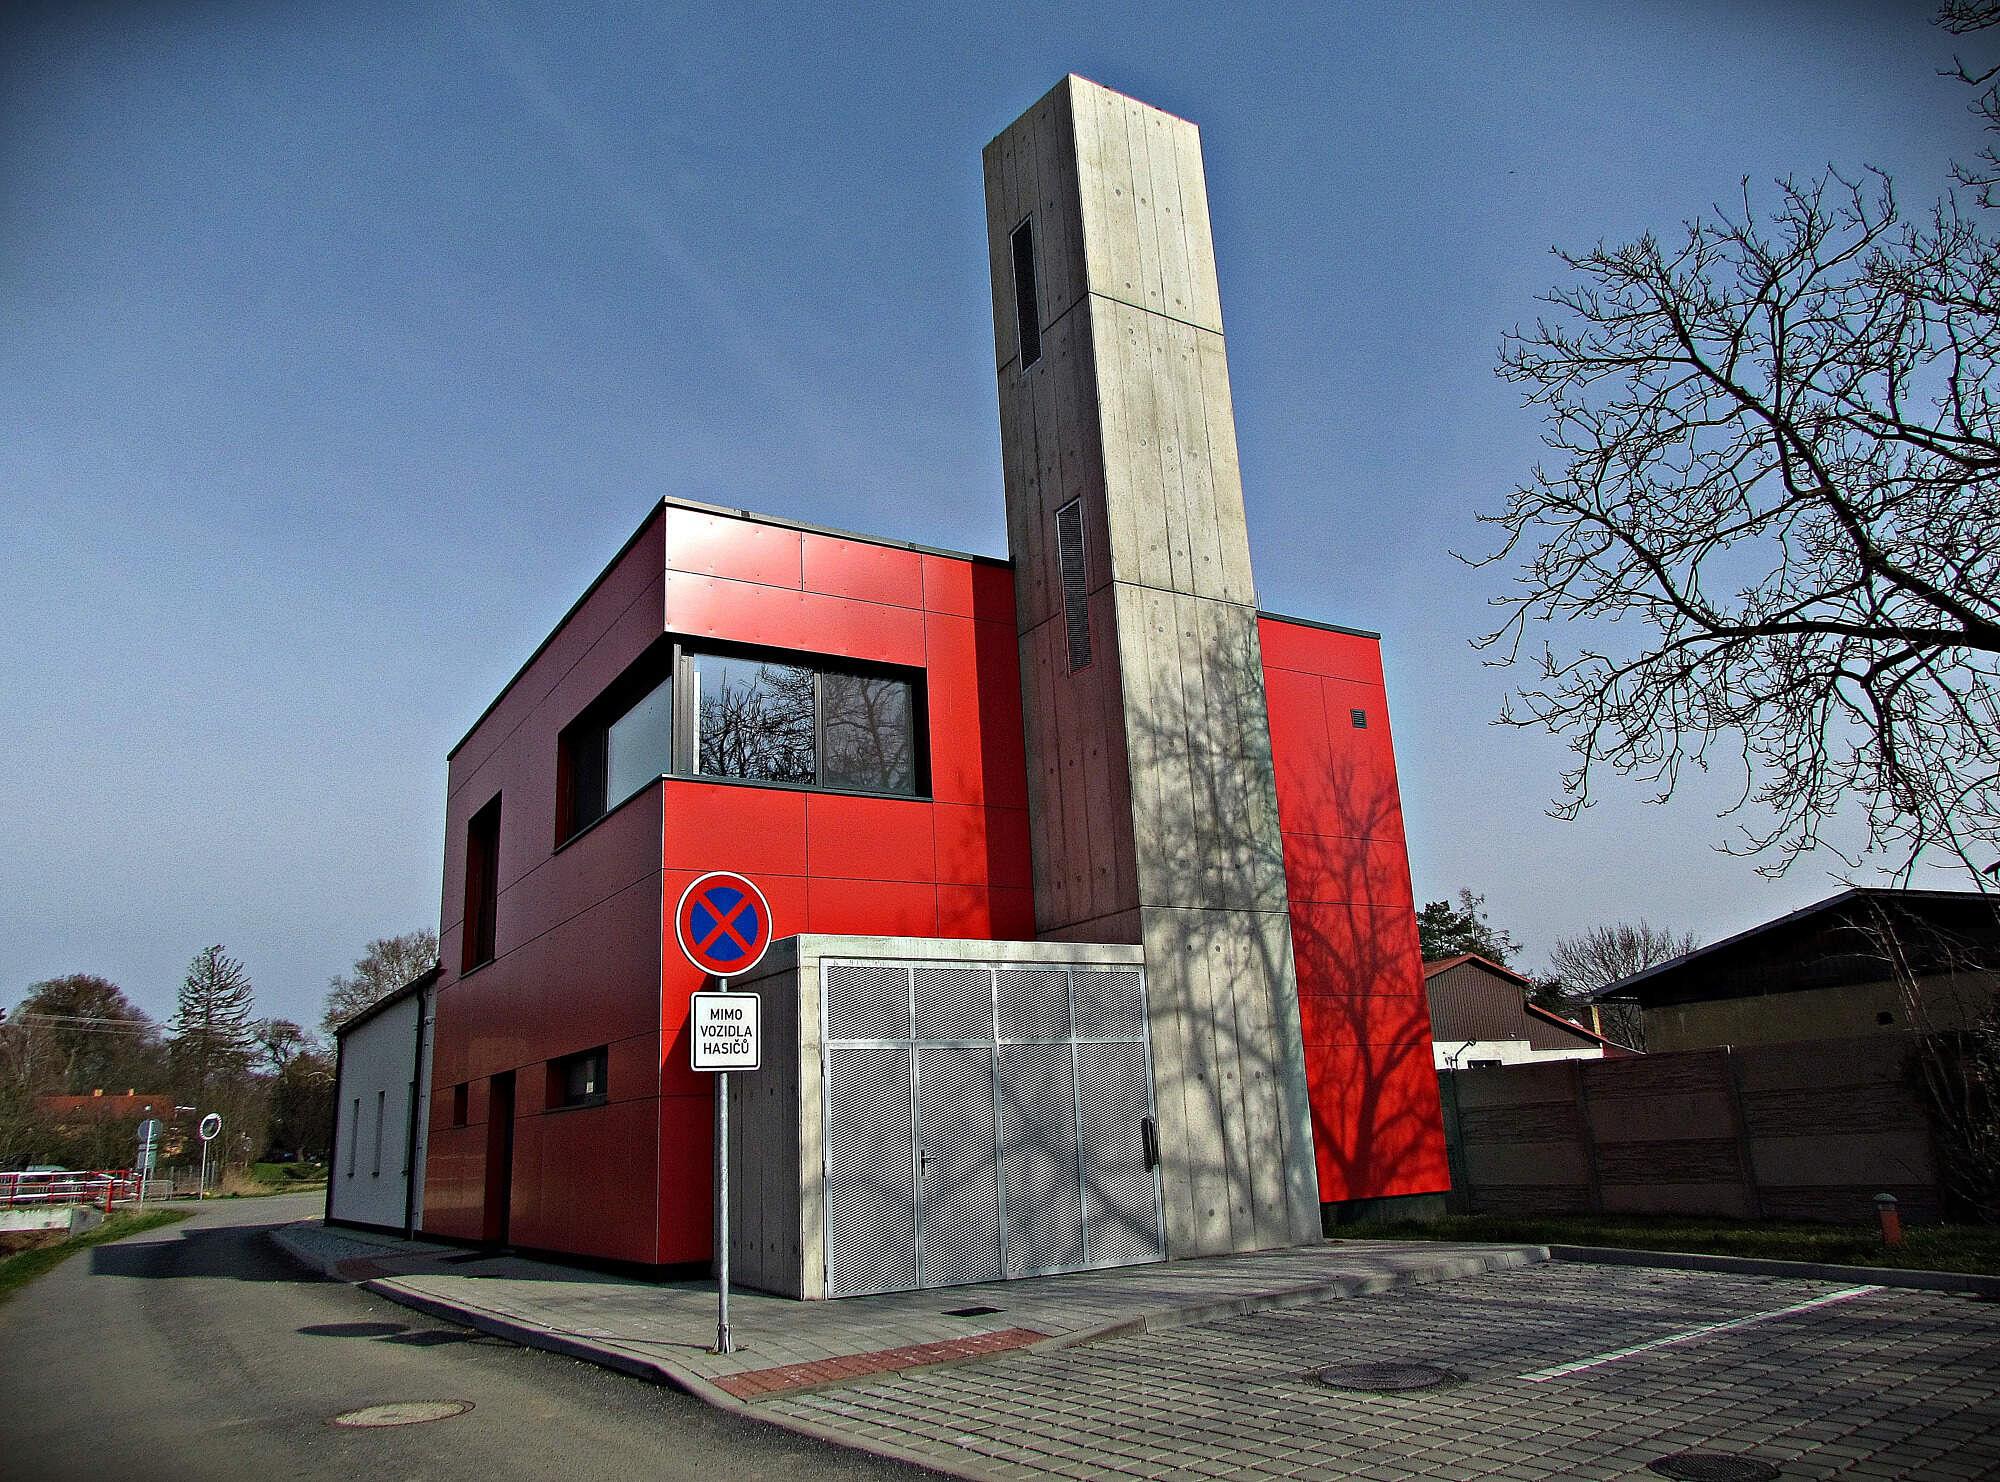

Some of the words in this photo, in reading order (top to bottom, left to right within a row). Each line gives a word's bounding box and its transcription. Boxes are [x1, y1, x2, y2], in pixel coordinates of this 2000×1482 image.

[710, 1008, 742, 1020] MIMO
[700, 1025, 752, 1037] VOZIDLA
[703, 1038, 749, 1054] HASIČŮ
